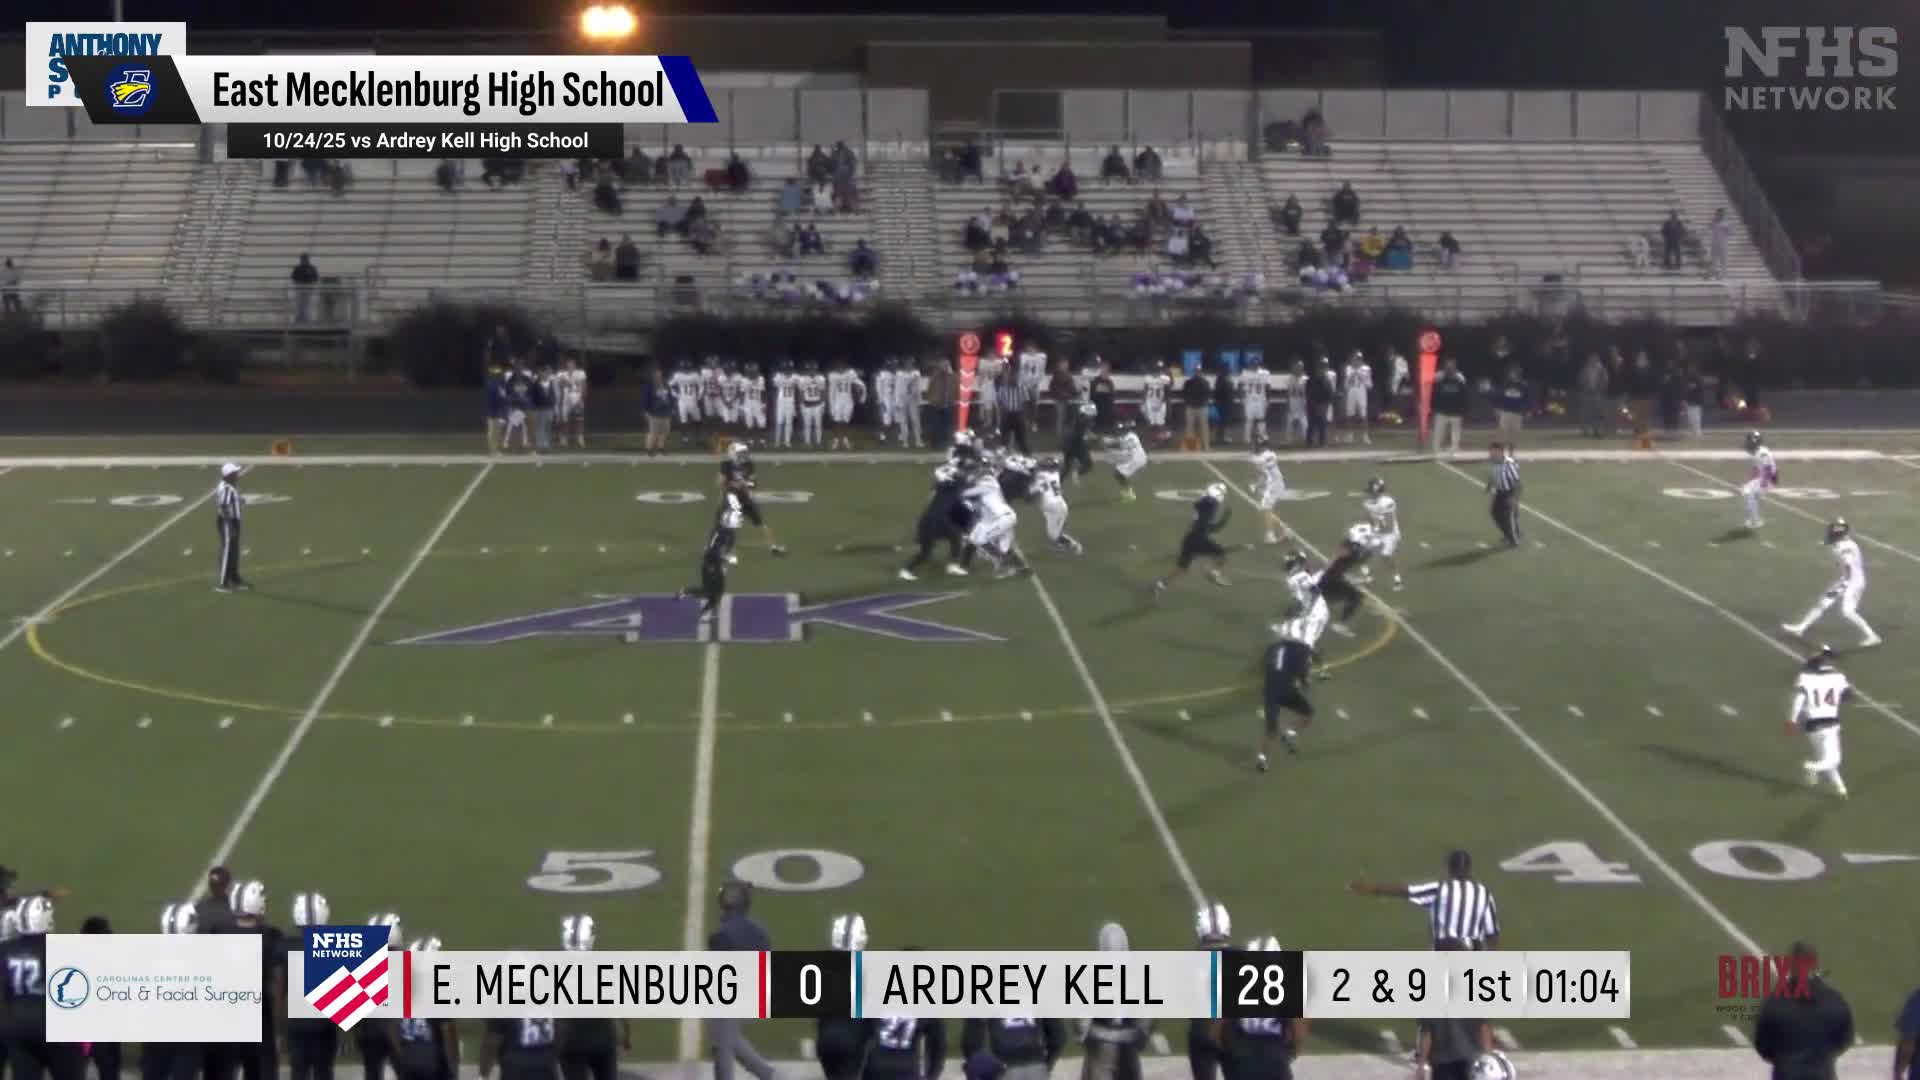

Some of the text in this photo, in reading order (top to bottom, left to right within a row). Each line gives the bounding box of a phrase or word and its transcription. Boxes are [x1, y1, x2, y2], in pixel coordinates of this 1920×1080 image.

[1001, 335, 1013, 356] 2
[1813, 687, 1837, 707] 14
[8, 958, 43, 996] 72
